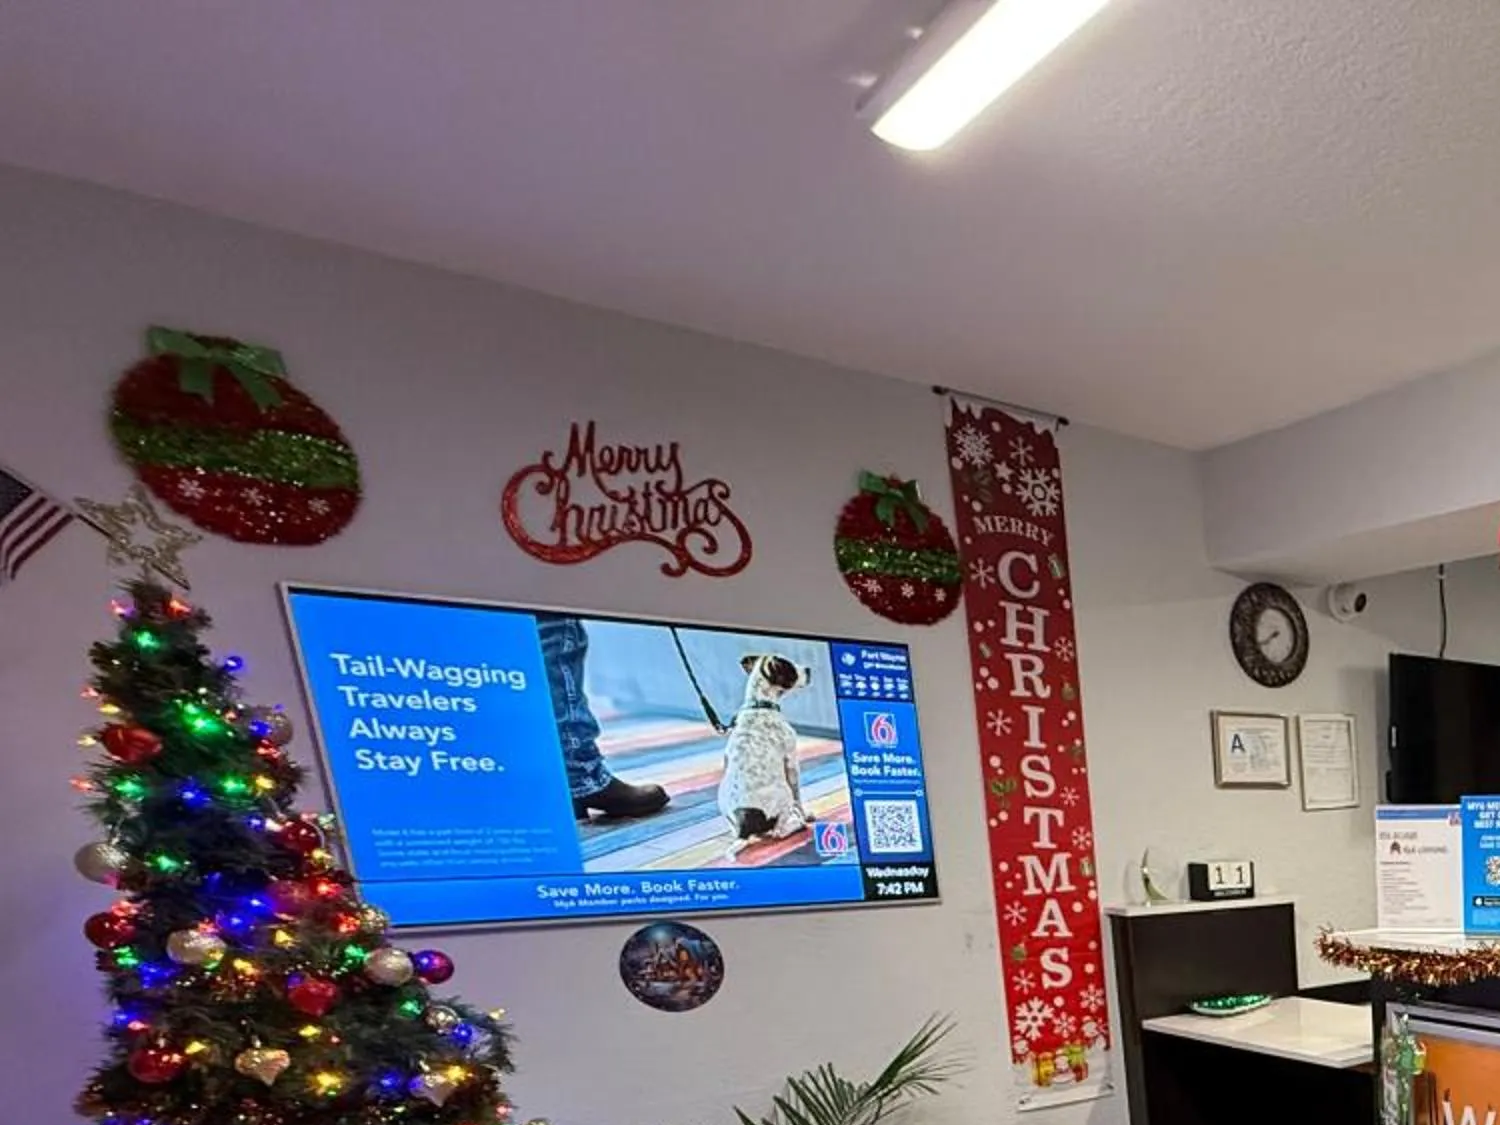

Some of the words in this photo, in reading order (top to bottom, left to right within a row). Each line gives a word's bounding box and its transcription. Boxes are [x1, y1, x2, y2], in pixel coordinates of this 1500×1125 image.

[562, 420, 688, 500] Merry
[501, 464, 753, 577] Christmas
[972, 516, 1056, 548] MERRY
[329, 653, 527, 691] Tail-Wagging
[337, 685, 478, 713] Travelers
[349, 718, 457, 747] Always
[1231, 733, 1246, 754] A
[355, 749, 421, 777] Stay
[430, 751, 505, 773] Free.
[851, 764, 881, 777] Book
[998, 550, 1076, 990] CHRISTMAS
[866, 866, 930, 879] Wednesday
[536, 884, 579, 899] Save
[584, 883, 636, 897] More.
[641, 880, 683, 894] Book
[687, 879, 740, 892] Faster.
[876, 882, 902, 896] 7:42
[904, 881, 925, 895] PM
